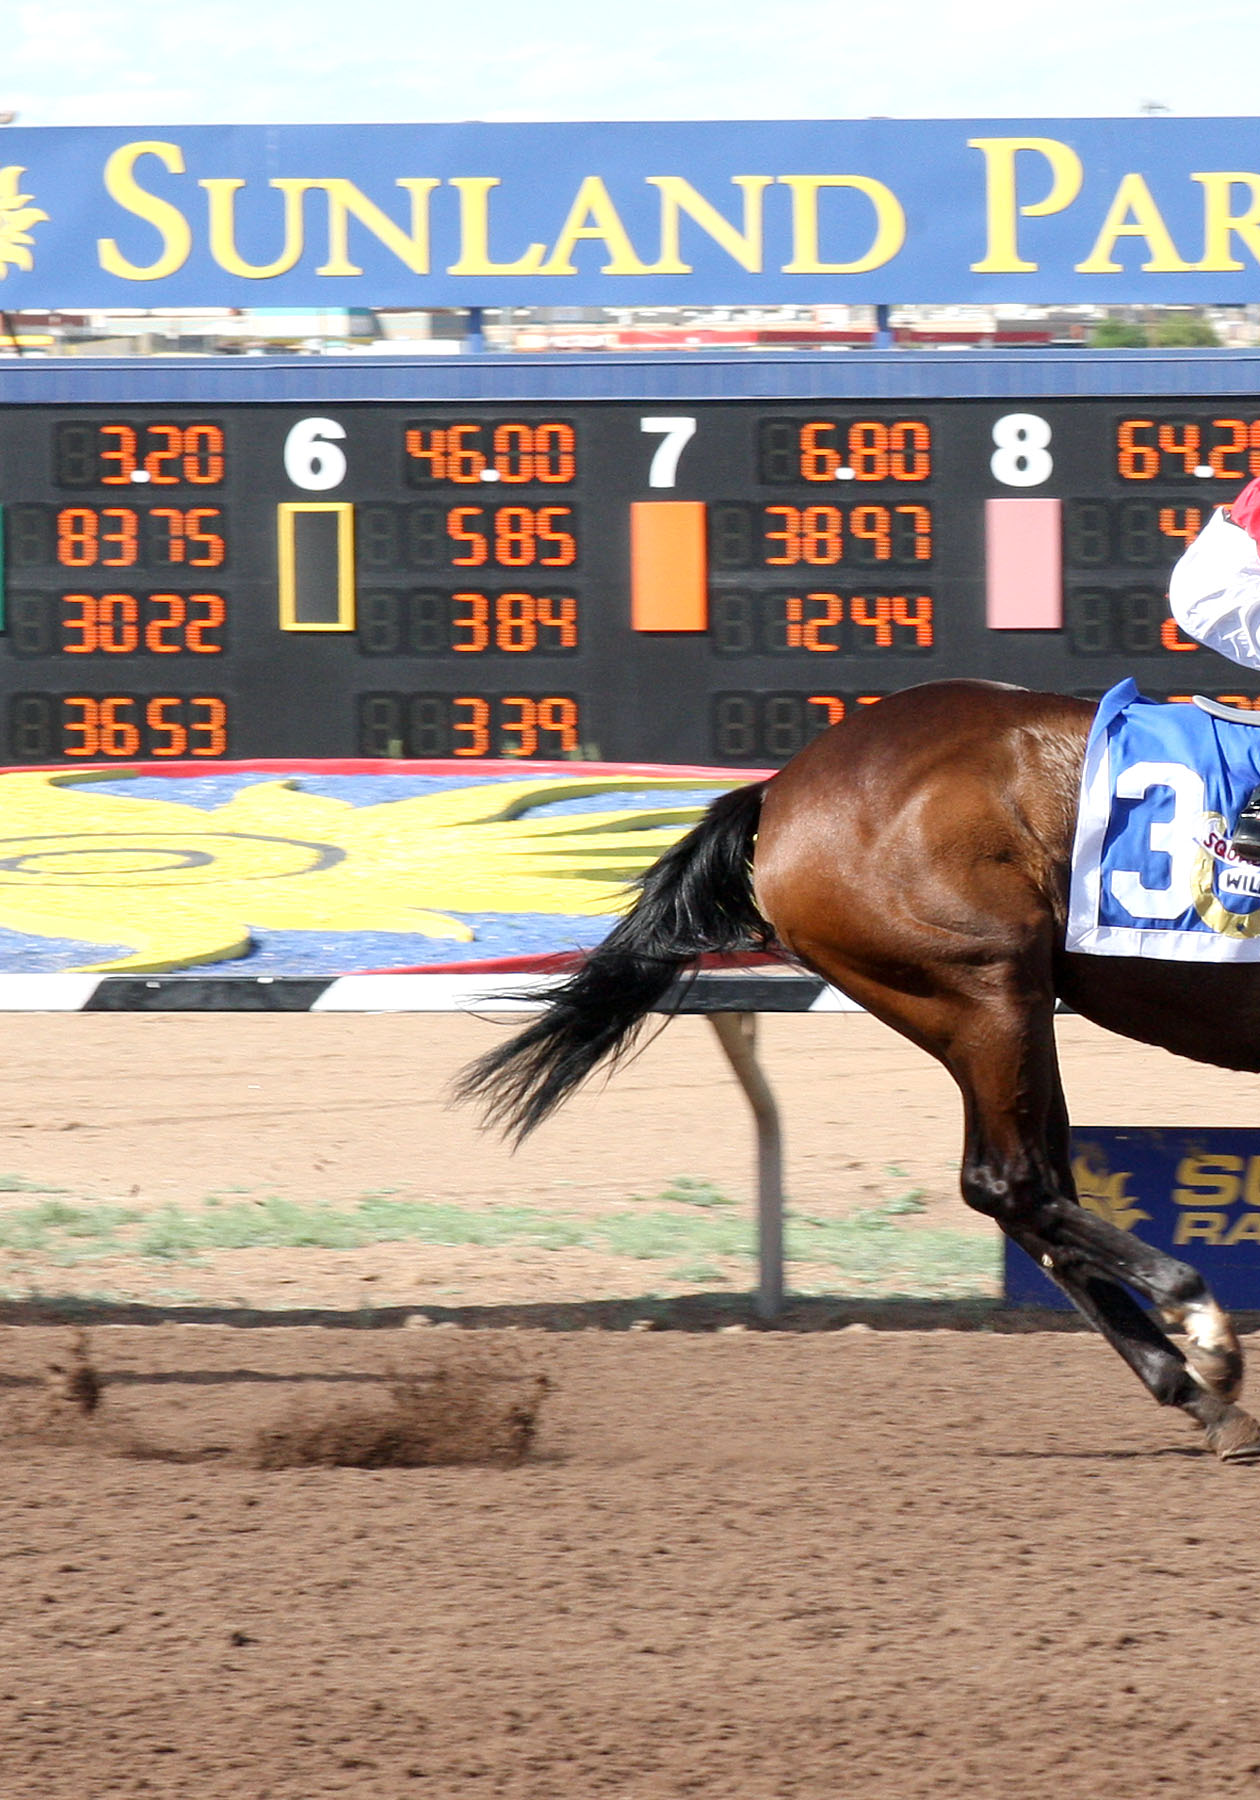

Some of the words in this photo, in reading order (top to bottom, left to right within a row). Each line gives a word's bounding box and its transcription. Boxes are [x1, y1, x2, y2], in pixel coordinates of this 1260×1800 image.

[97, 141, 907, 281] SUNLAND
[100, 425, 224, 485] 3.20
[284, 417, 347, 491] 6
[406, 423, 575, 484] 46.00
[641, 417, 696, 488] 7
[800, 421, 931, 482] 6.80
[991, 413, 1053, 487] 8
[58, 508, 225, 567] 8375
[447, 506, 576, 567] 585
[765, 505, 931, 565] 3897
[63, 594, 225, 653] 3022
[452, 593, 577, 652] 384
[786, 593, 933, 652] 1244
[63, 697, 226, 756] 3653
[453, 697, 578, 756] 339
[1110, 761, 1206, 921] 3
